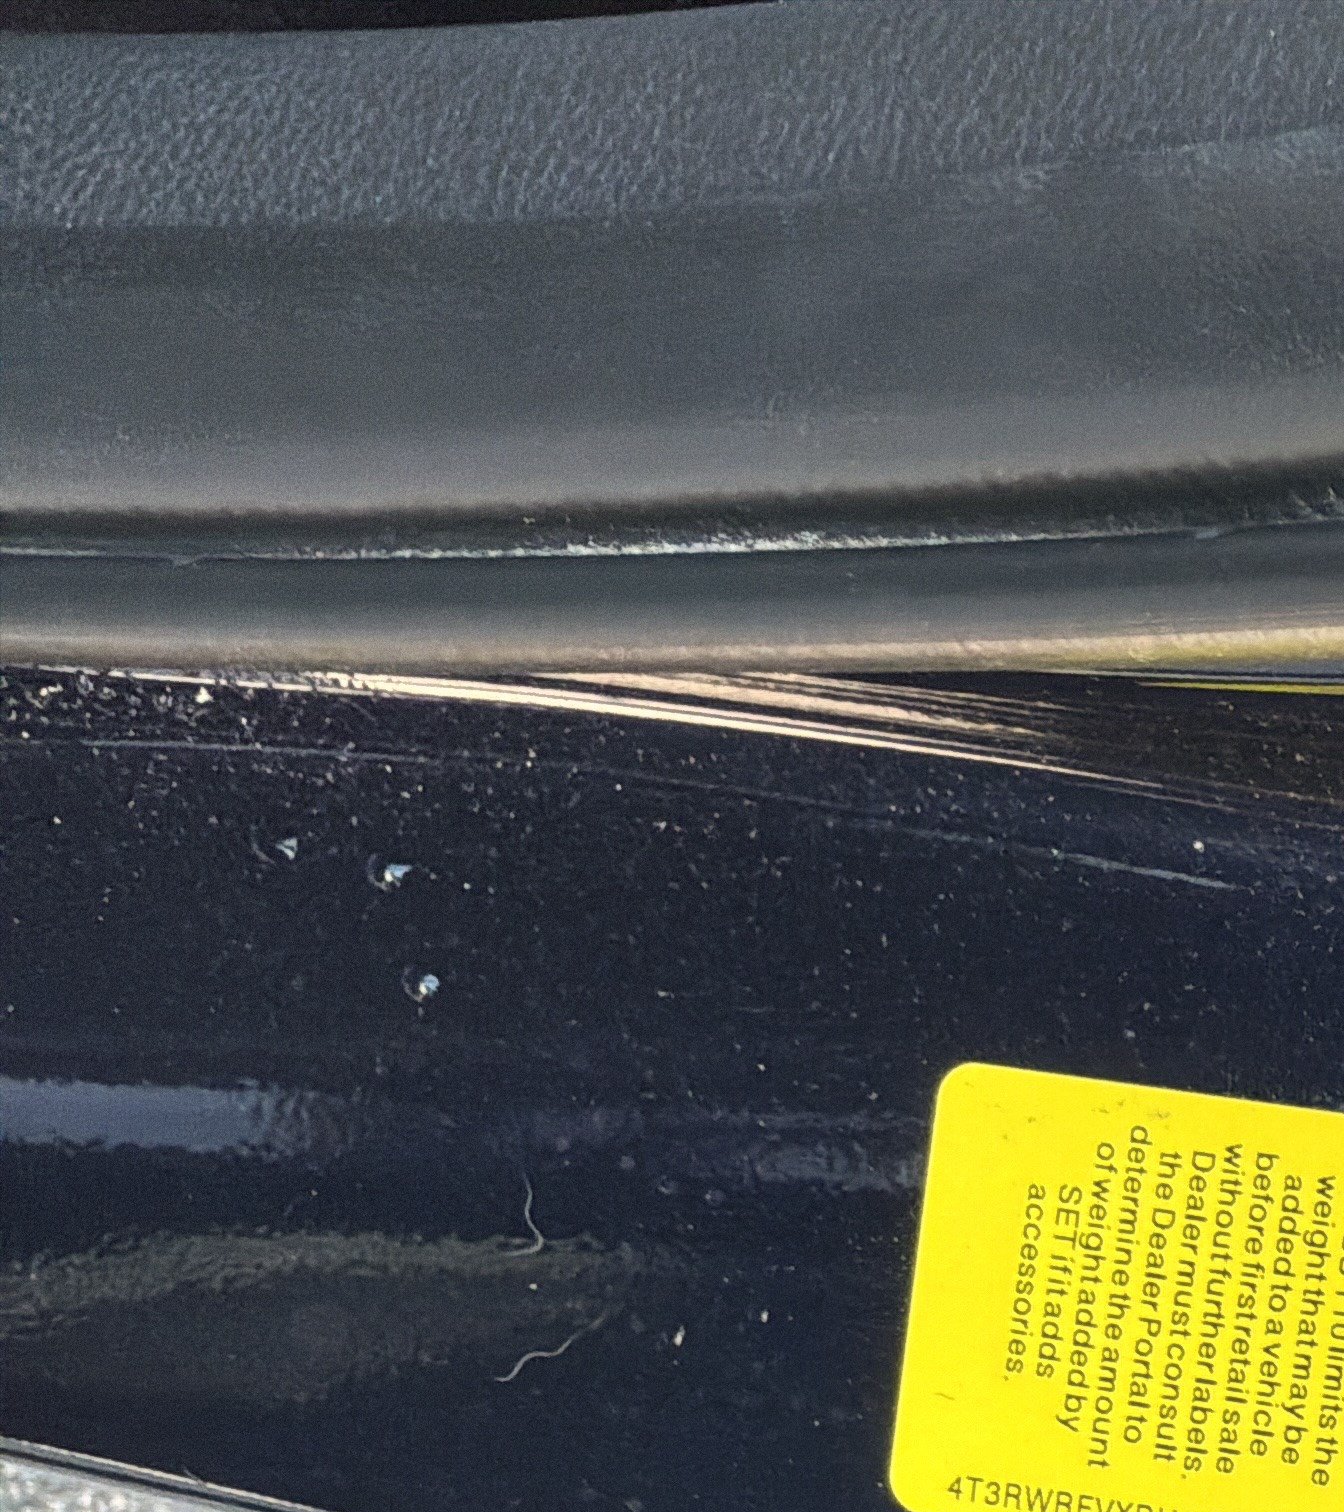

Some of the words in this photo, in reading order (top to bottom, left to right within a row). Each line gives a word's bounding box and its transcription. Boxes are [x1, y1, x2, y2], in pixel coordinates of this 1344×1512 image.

[1094, 1142, 1118, 1175] of
[1154, 1151, 1183, 1201] the
[1053, 1184, 1083, 1251] SET
[1078, 1178, 1111, 1284] weight
[1111, 1125, 1153, 1287] determine
[1180, 1150, 1217, 1256] Dealer
[1210, 1143, 1246, 1262] without
[1244, 1152, 1280, 1255] before
[1272, 1174, 1305, 1278] added
[1302, 1175, 1336, 1283] weight
[1003, 1183, 1047, 1381] accessories.
[1045, 1277, 1072, 1297] it
[1049, 1254, 1075, 1276] if
[1140, 1207, 1176, 1313] Dealer
[1169, 1259, 1196, 1338] must
[1235, 1261, 1266, 1321] first
[1268, 1283, 1293, 1313] to
[1035, 1301, 1064, 1379] adds
[1066, 1288, 1098, 1389] added
[1104, 1292, 1131, 1341] the
[1196, 1268, 1232, 1374] further
[1264, 1318, 1284, 1336] a
[1295, 1287, 1326, 1349] that
[1127, 1317, 1162, 1409] Portal
[1153, 1342, 1186, 1462] consult
[1224, 1325, 1252, 1405] retail
[1249, 1342, 1282, 1457] vehicle
[1280, 1352, 1312, 1421] may
[1055, 1393, 1088, 1433] by
[1087, 1346, 1120, 1468] amount
[1123, 1414, 1148, 1444] to
[1181, 1377, 1218, 1479] labels.
[1215, 1408, 1242, 1474] sale
[1281, 1424, 1309, 1465] be
[1310, 1436, 1339, 1487] the
